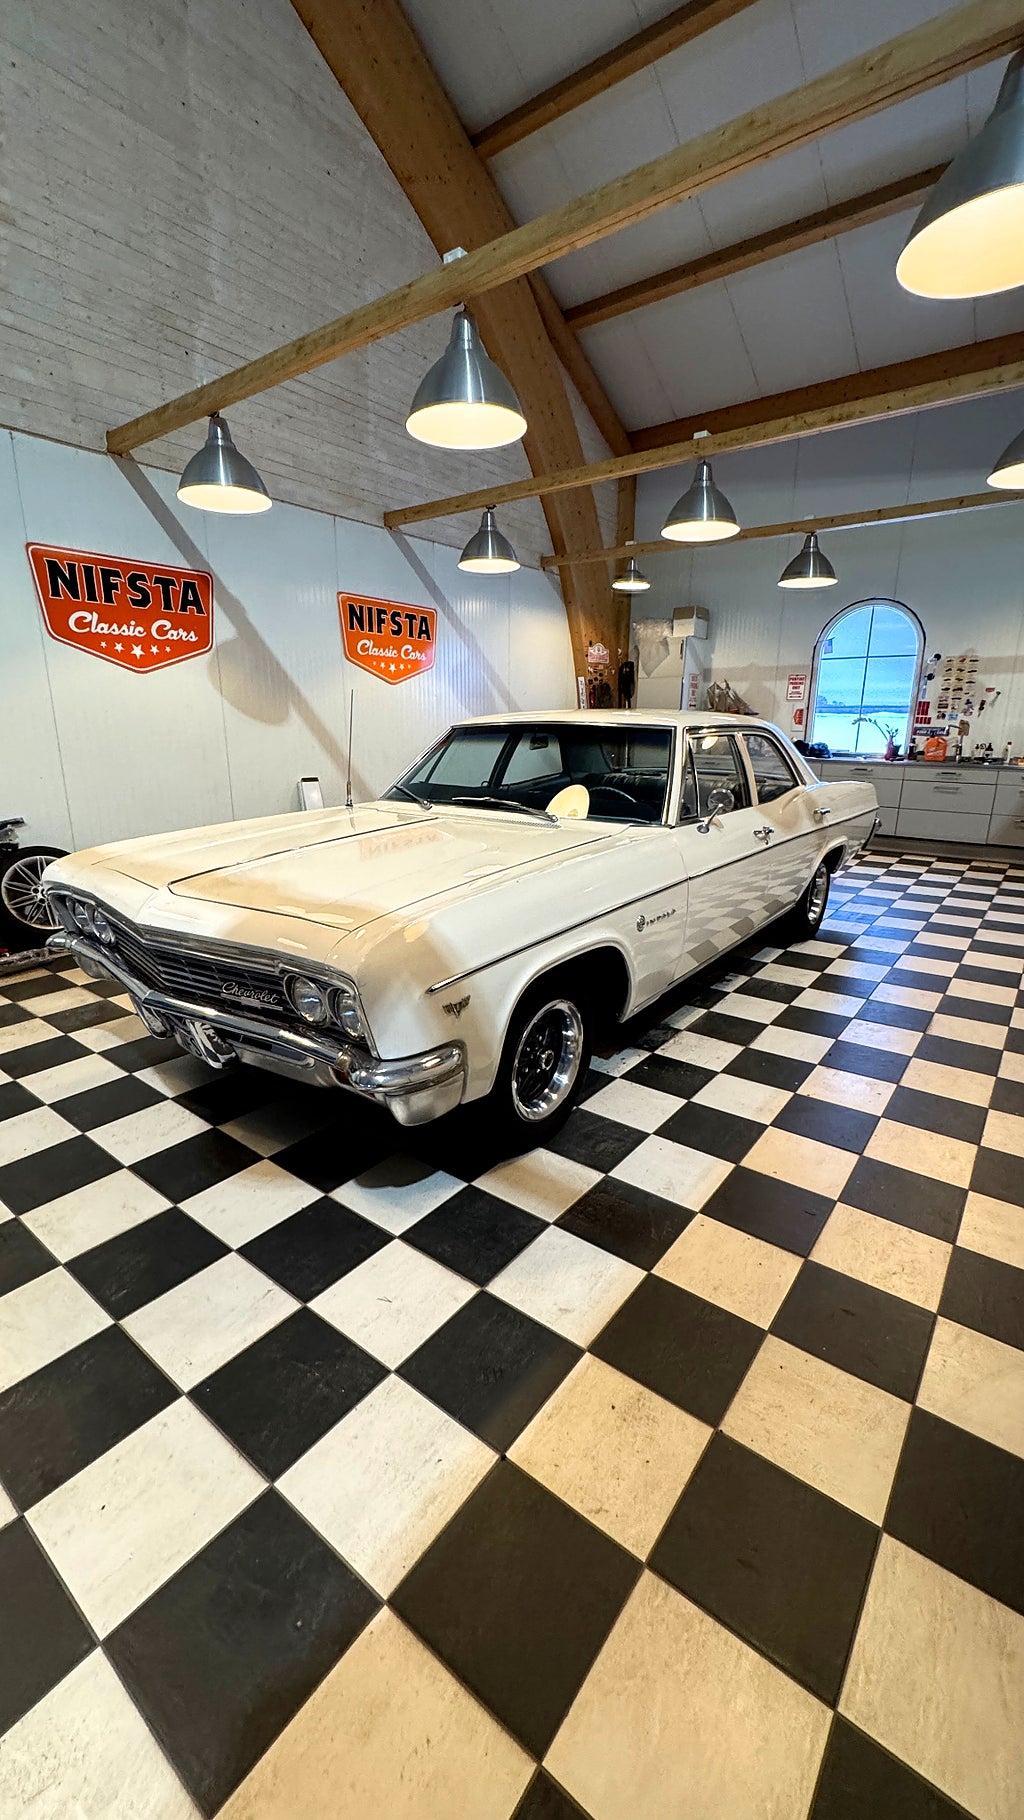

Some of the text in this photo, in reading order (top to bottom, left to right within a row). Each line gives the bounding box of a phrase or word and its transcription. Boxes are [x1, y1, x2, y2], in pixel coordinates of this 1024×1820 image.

[44, 558, 207, 616] NIFSTA
[68, 610, 198, 642] Classic Cars
[347, 602, 432, 642] NIFSTA
[357, 639, 426, 661] Classic Cars
[222, 981, 280, 1004] Chevrolet
